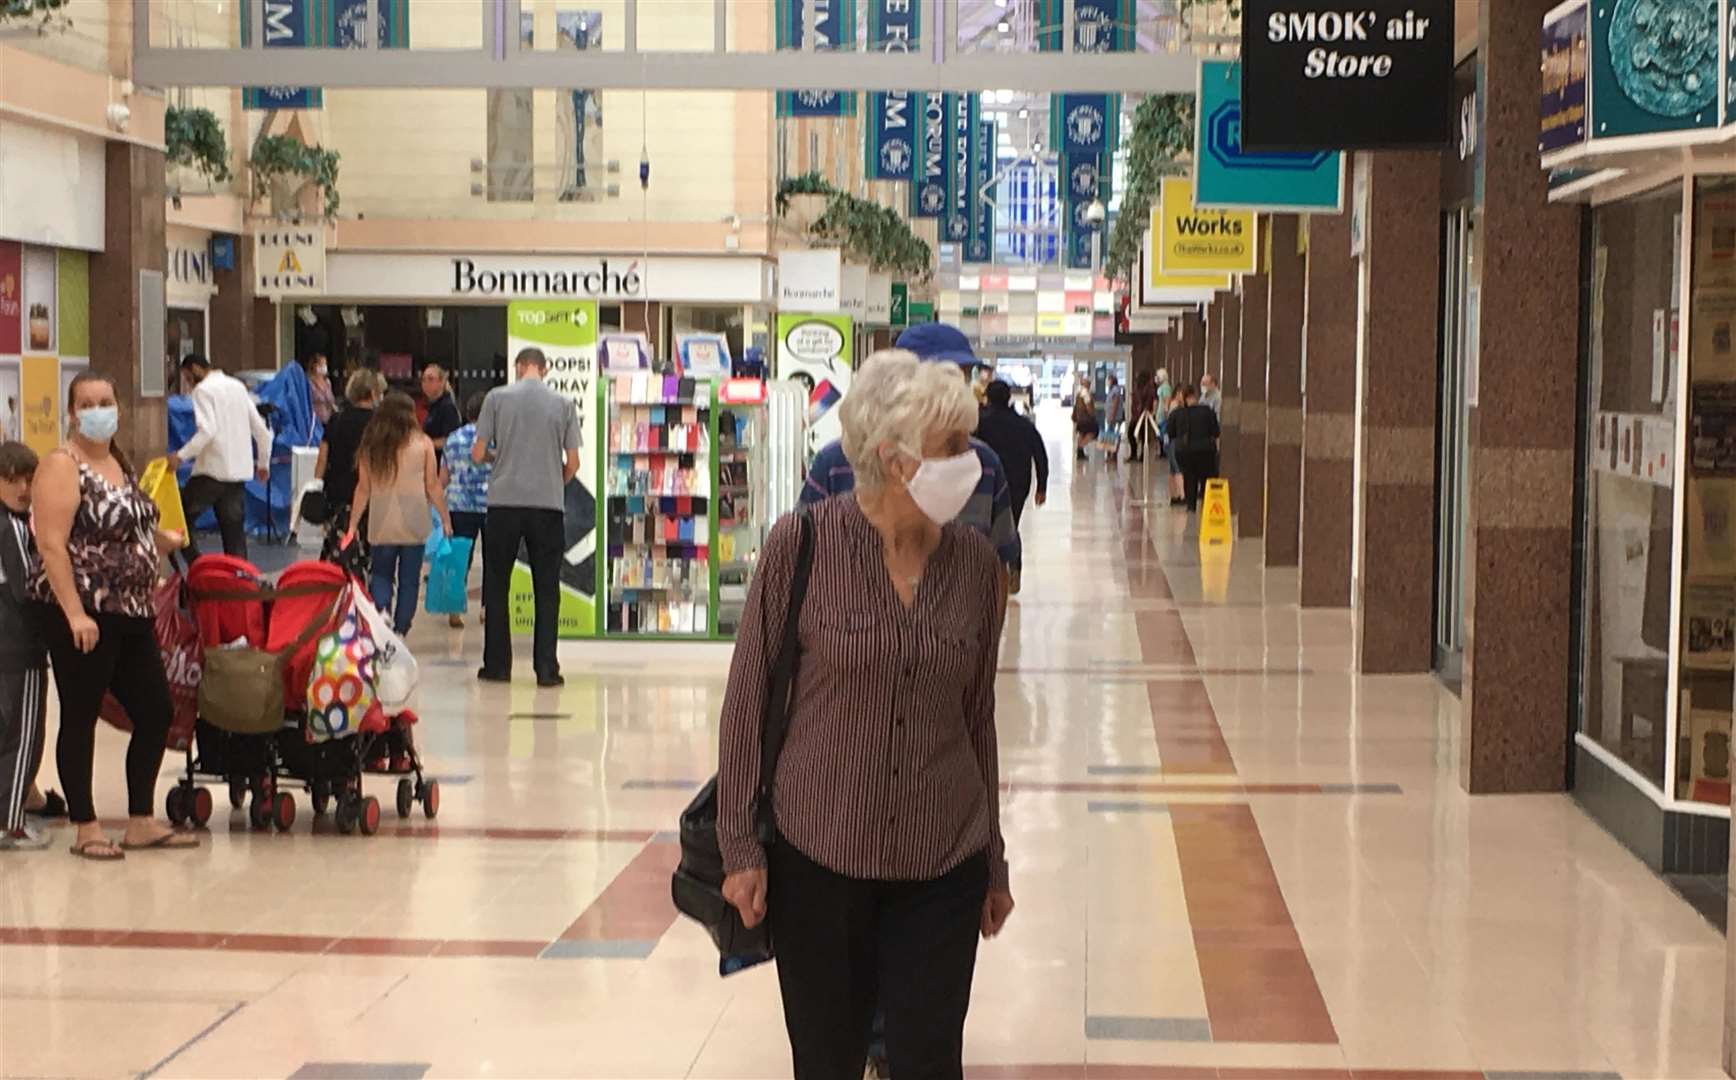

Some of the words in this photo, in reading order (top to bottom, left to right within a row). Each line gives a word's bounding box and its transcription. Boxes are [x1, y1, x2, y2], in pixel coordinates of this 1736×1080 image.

[1267, 11, 1376, 42] SMOK'
[1386, 9, 1430, 40] air
[1303, 47, 1393, 79] Store
[1176, 216, 1242, 236] Works
[452, 258, 640, 295] Bonmarché
